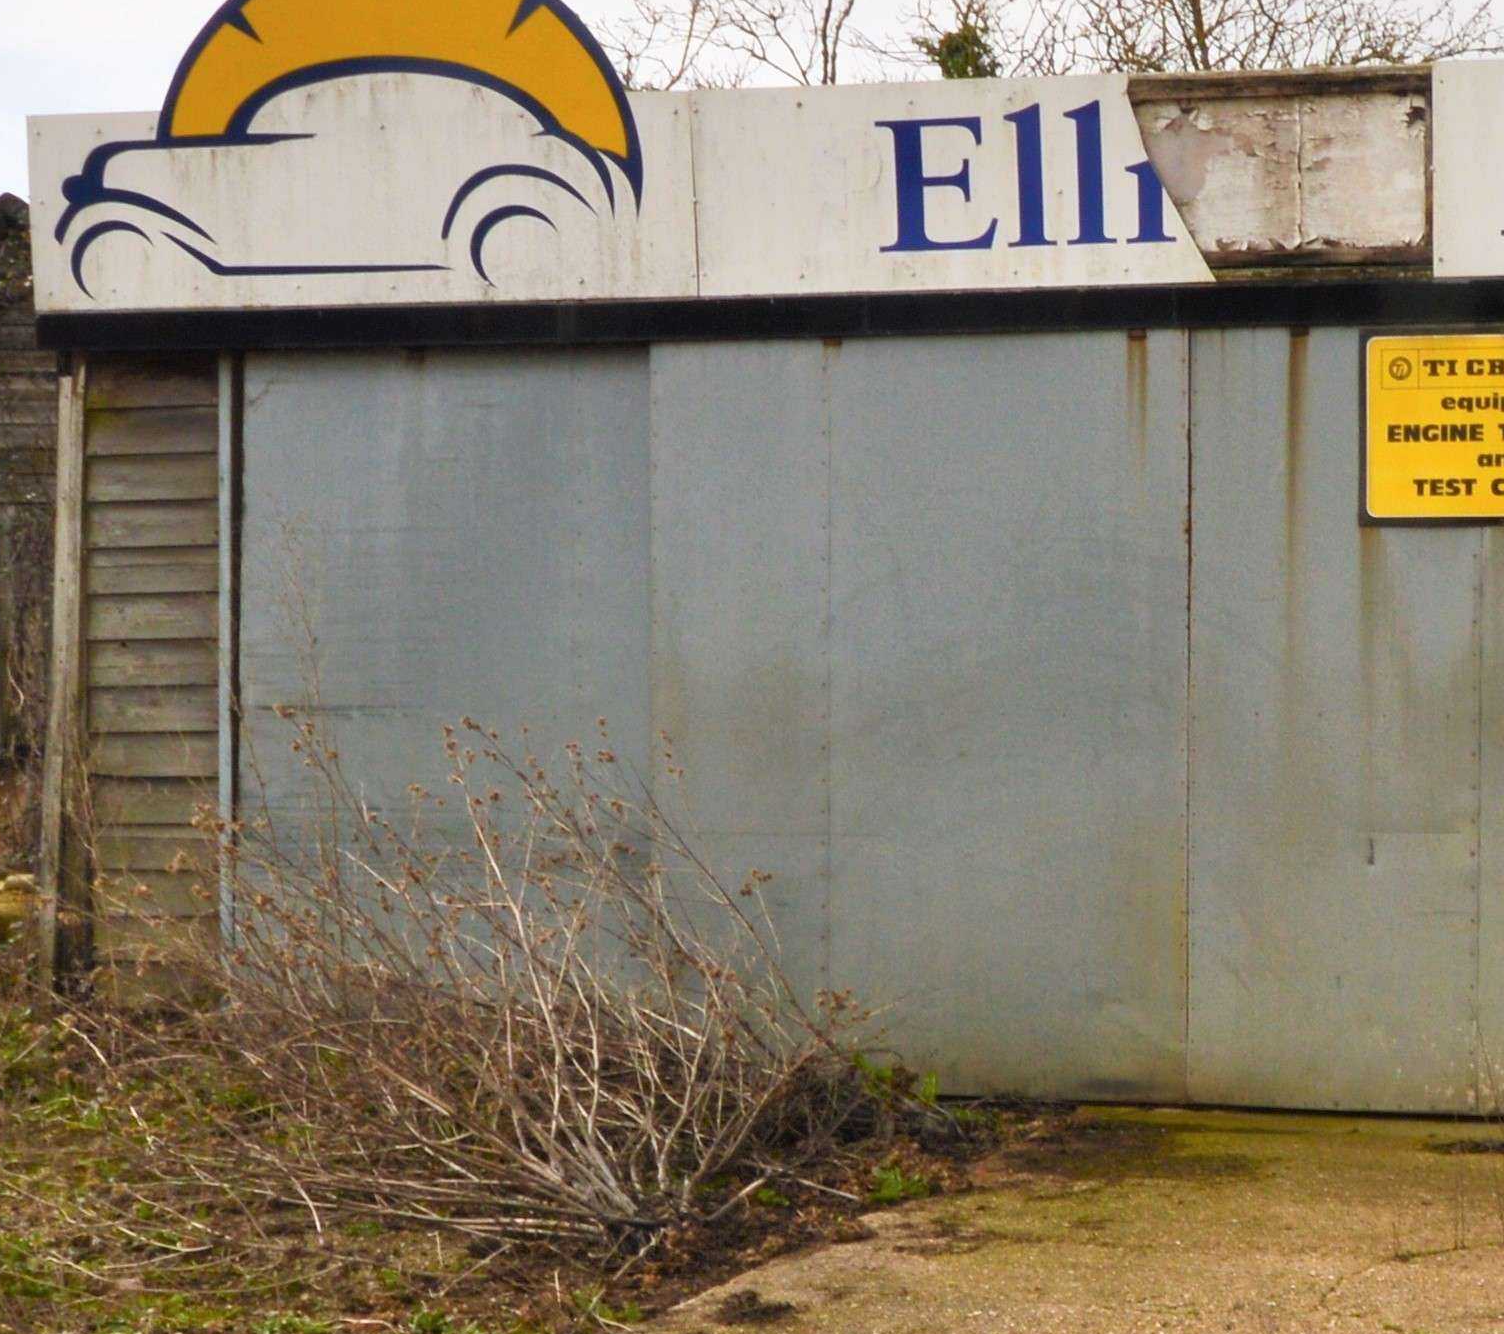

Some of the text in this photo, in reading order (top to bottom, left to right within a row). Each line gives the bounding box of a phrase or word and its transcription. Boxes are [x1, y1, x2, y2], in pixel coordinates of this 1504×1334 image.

[1423, 359, 1457, 377] TI
[1387, 424, 1484, 443] ENGINE
[1413, 478, 1478, 497] TEST
